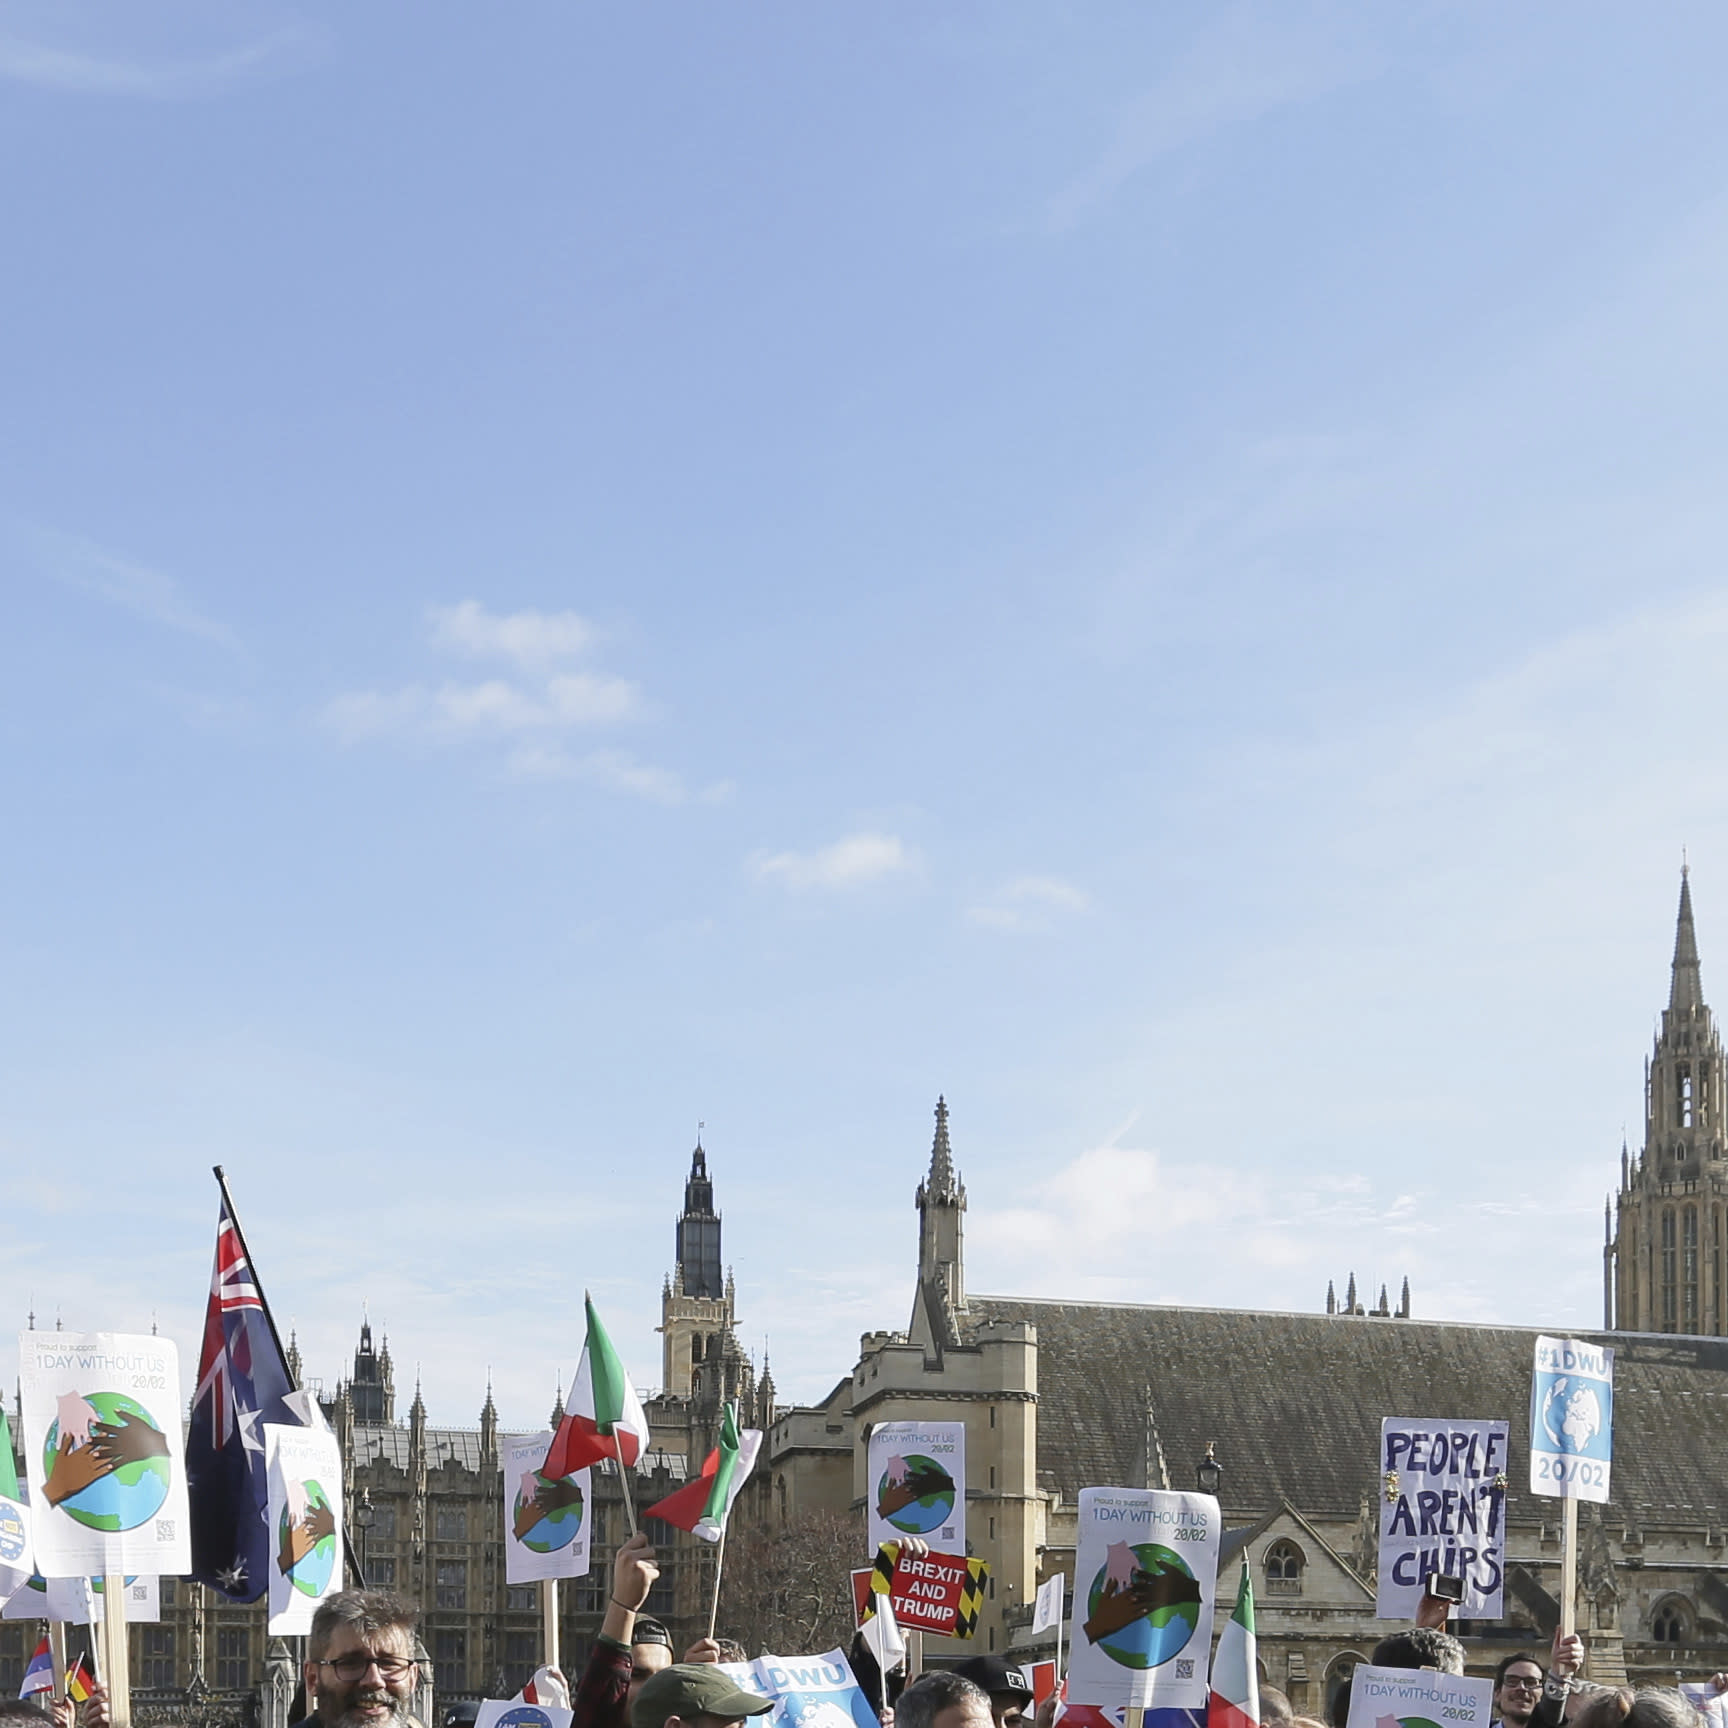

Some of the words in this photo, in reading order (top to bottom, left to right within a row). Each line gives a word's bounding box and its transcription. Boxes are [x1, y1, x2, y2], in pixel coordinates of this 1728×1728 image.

[37, 1355, 73, 1369] 1DAY
[78, 1356, 144, 1372] WITHOUT
[1538, 1346, 1610, 1376] #1DWU
[132, 1375, 165, 1390] 20/02
[1386, 1432, 1505, 1479] PEOPLE
[1538, 1457, 1604, 1488] 20/02
[1093, 1508, 1127, 1520] 1DAY
[1129, 1510, 1188, 1524] WITHOUT
[1191, 1513, 1207, 1526] US
[1388, 1486, 1505, 1538] AREN'T
[1174, 1528, 1206, 1541] 20/02
[898, 1558, 964, 1584] BREXIT
[908, 1581, 946, 1600] AND
[893, 1596, 954, 1621] TRUMP
[1364, 1684, 1395, 1696] 1DAY
[1398, 1686, 1457, 1703] WITHOUT
[1459, 1695, 1476, 1707] US
[1441, 1706, 1476, 1721] 20/02
